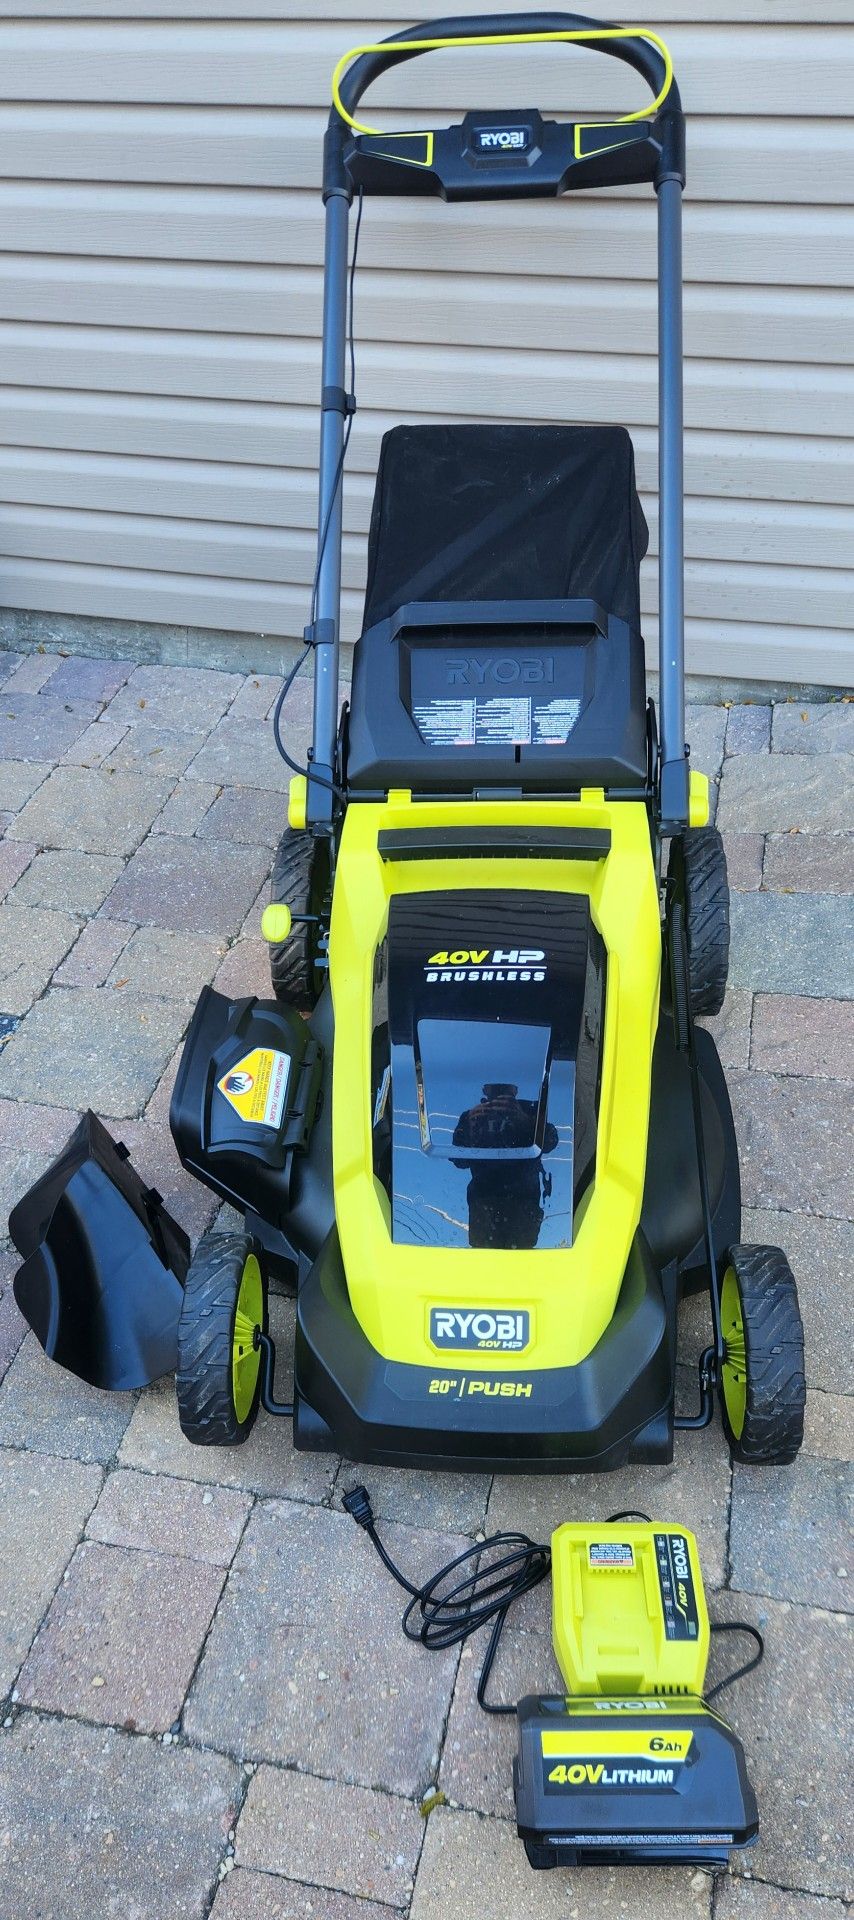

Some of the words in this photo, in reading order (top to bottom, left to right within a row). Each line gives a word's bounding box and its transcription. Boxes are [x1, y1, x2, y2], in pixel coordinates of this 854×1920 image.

[480, 132, 524, 146] RYOBI
[446, 658, 554, 684] RYOBI
[428, 951, 490, 965] 40V
[492, 950, 545, 963] HP
[426, 972, 545, 982] BRUSHLESS
[435, 1312, 523, 1340] RYOBI
[429, 1380, 457, 1394] 20"
[468, 1381, 532, 1397] PUSH
[672, 1539, 689, 1579] RYOBI
[678, 1582, 688, 1607] 40V
[594, 1701, 667, 1710] RYOBI
